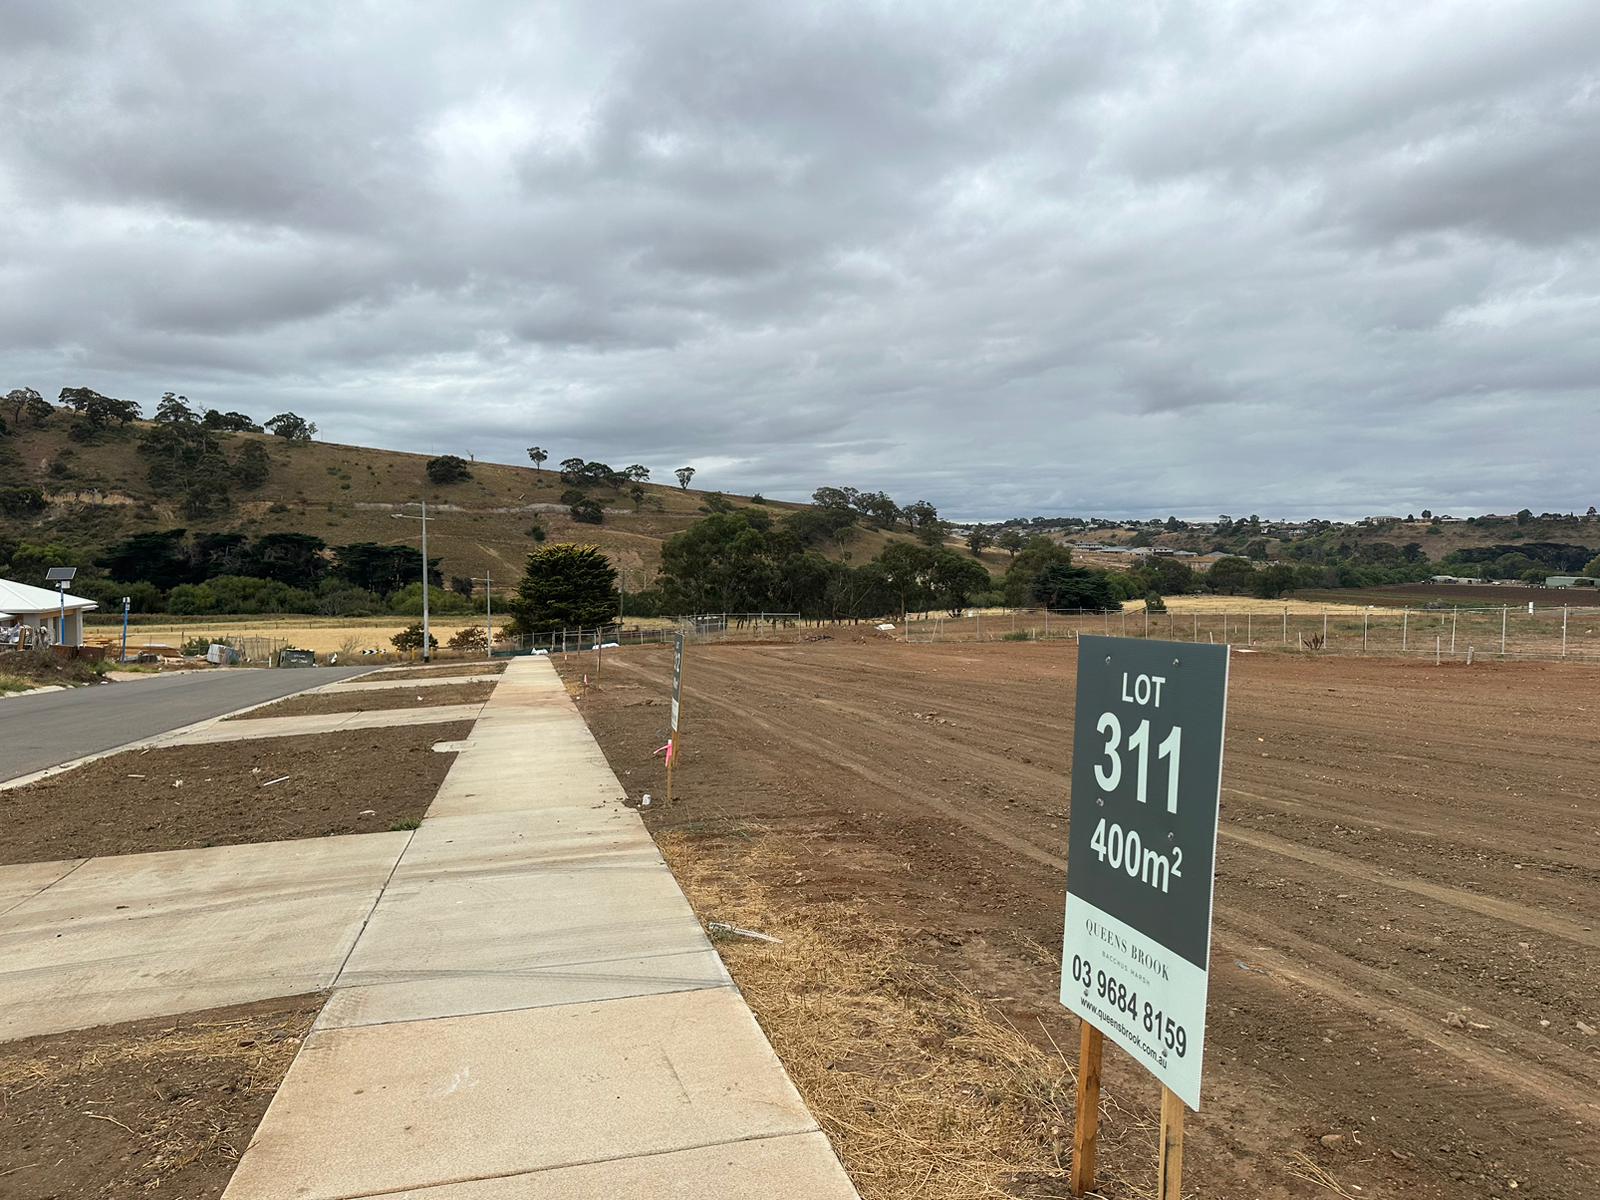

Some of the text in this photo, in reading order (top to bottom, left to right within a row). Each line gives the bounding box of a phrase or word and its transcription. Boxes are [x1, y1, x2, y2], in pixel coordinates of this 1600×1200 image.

[1122, 672, 1166, 708] LOT
[1094, 712, 1182, 814] 311
[1085, 918, 1169, 981] QUEENS BROOK
[1072, 954, 1187, 1058] 03 9684 8159
[1080, 996, 1168, 1069] www.queensbrook.com.au
